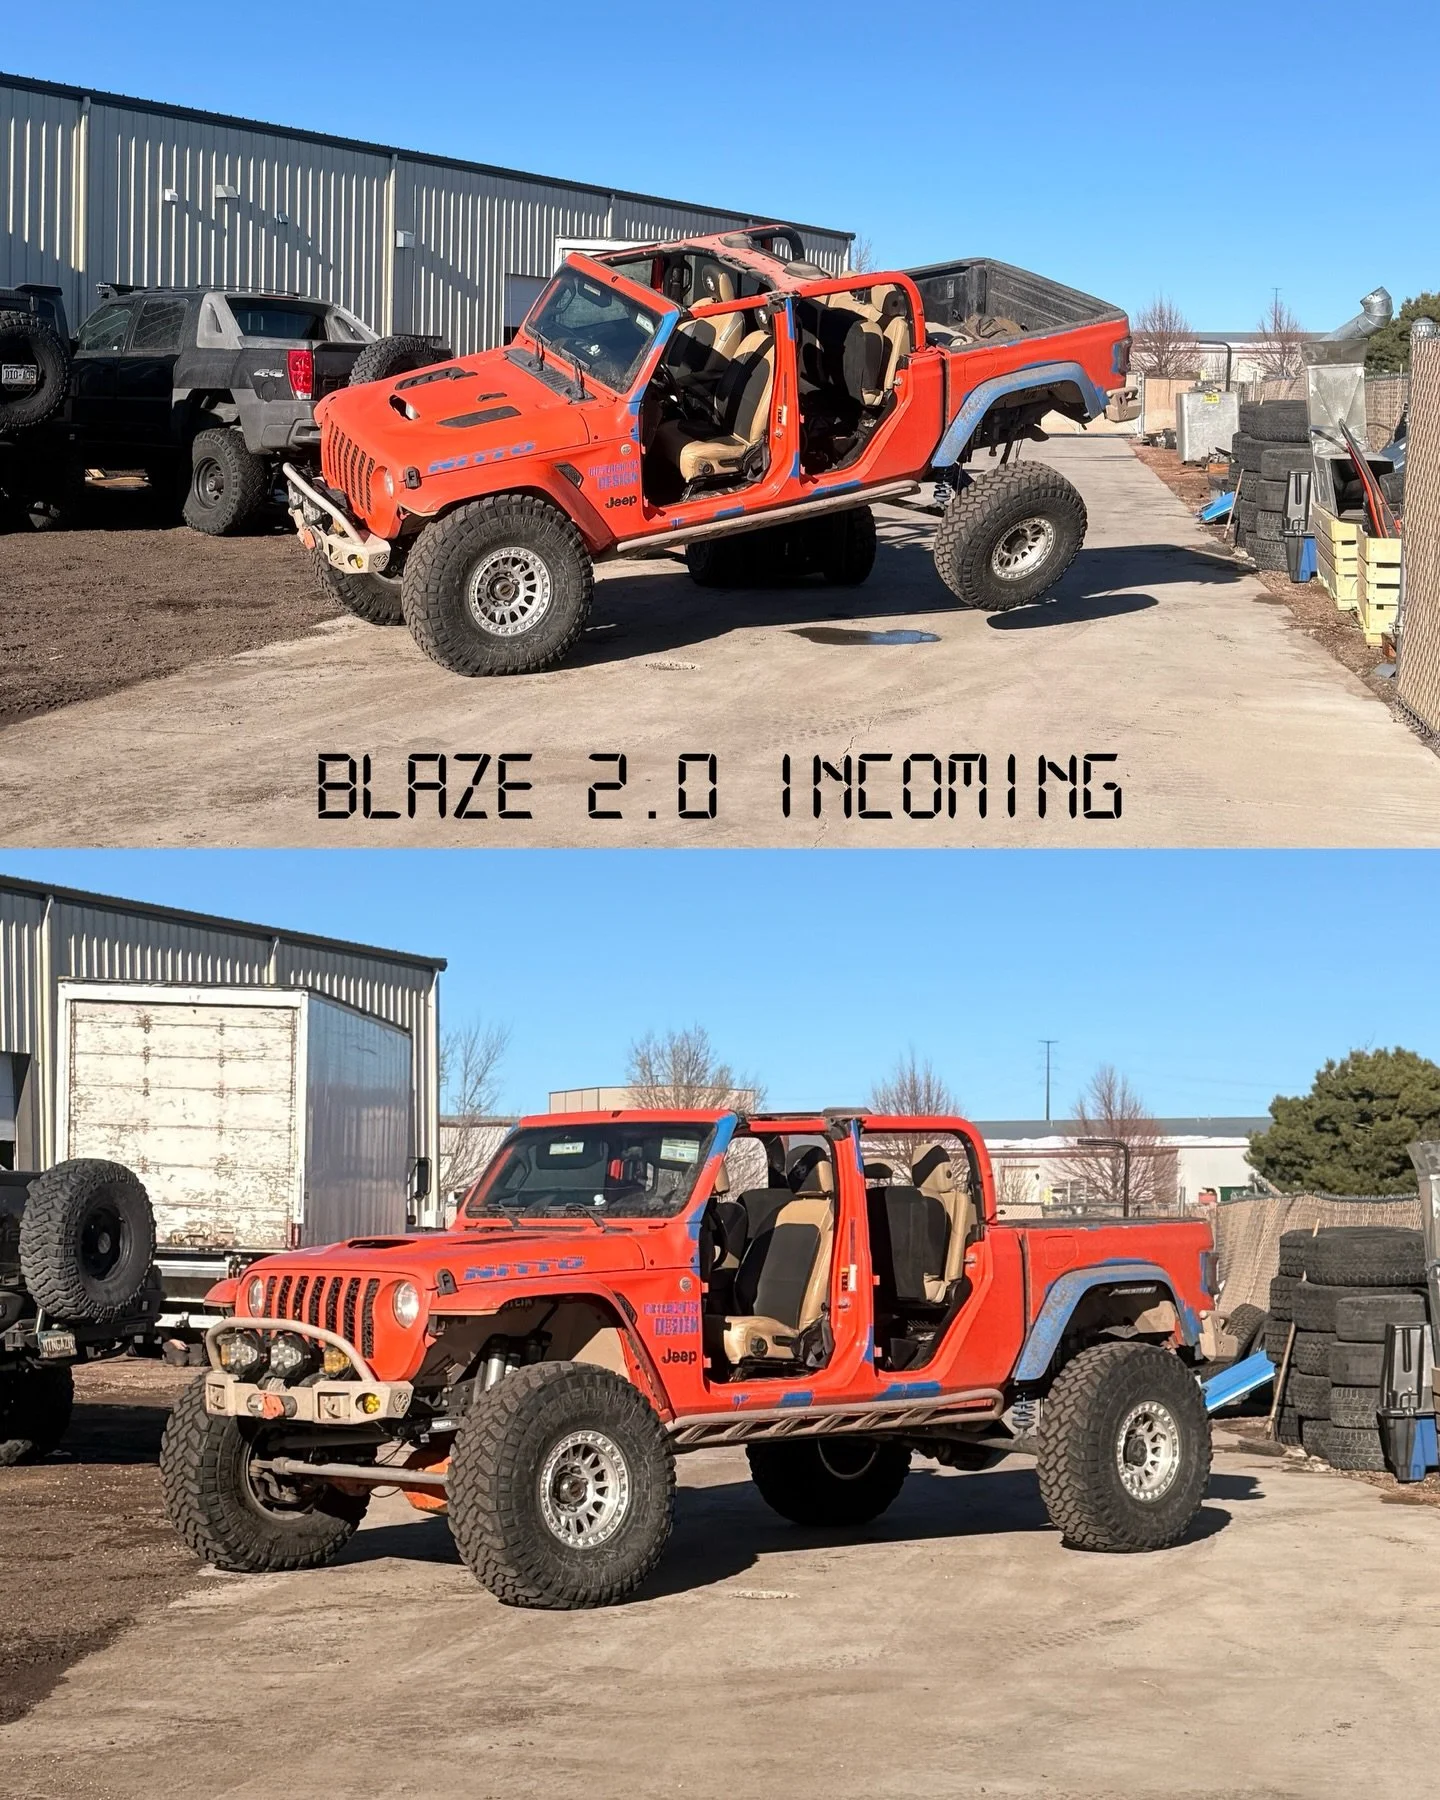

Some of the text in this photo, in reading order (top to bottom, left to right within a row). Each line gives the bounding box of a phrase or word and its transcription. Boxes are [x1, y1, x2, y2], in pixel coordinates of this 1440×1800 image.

[429, 441, 535, 472] NITTO
[605, 495, 637, 508] Jeep
[464, 1256, 586, 1280] NITTO
[661, 1347, 698, 1365] Jeep
